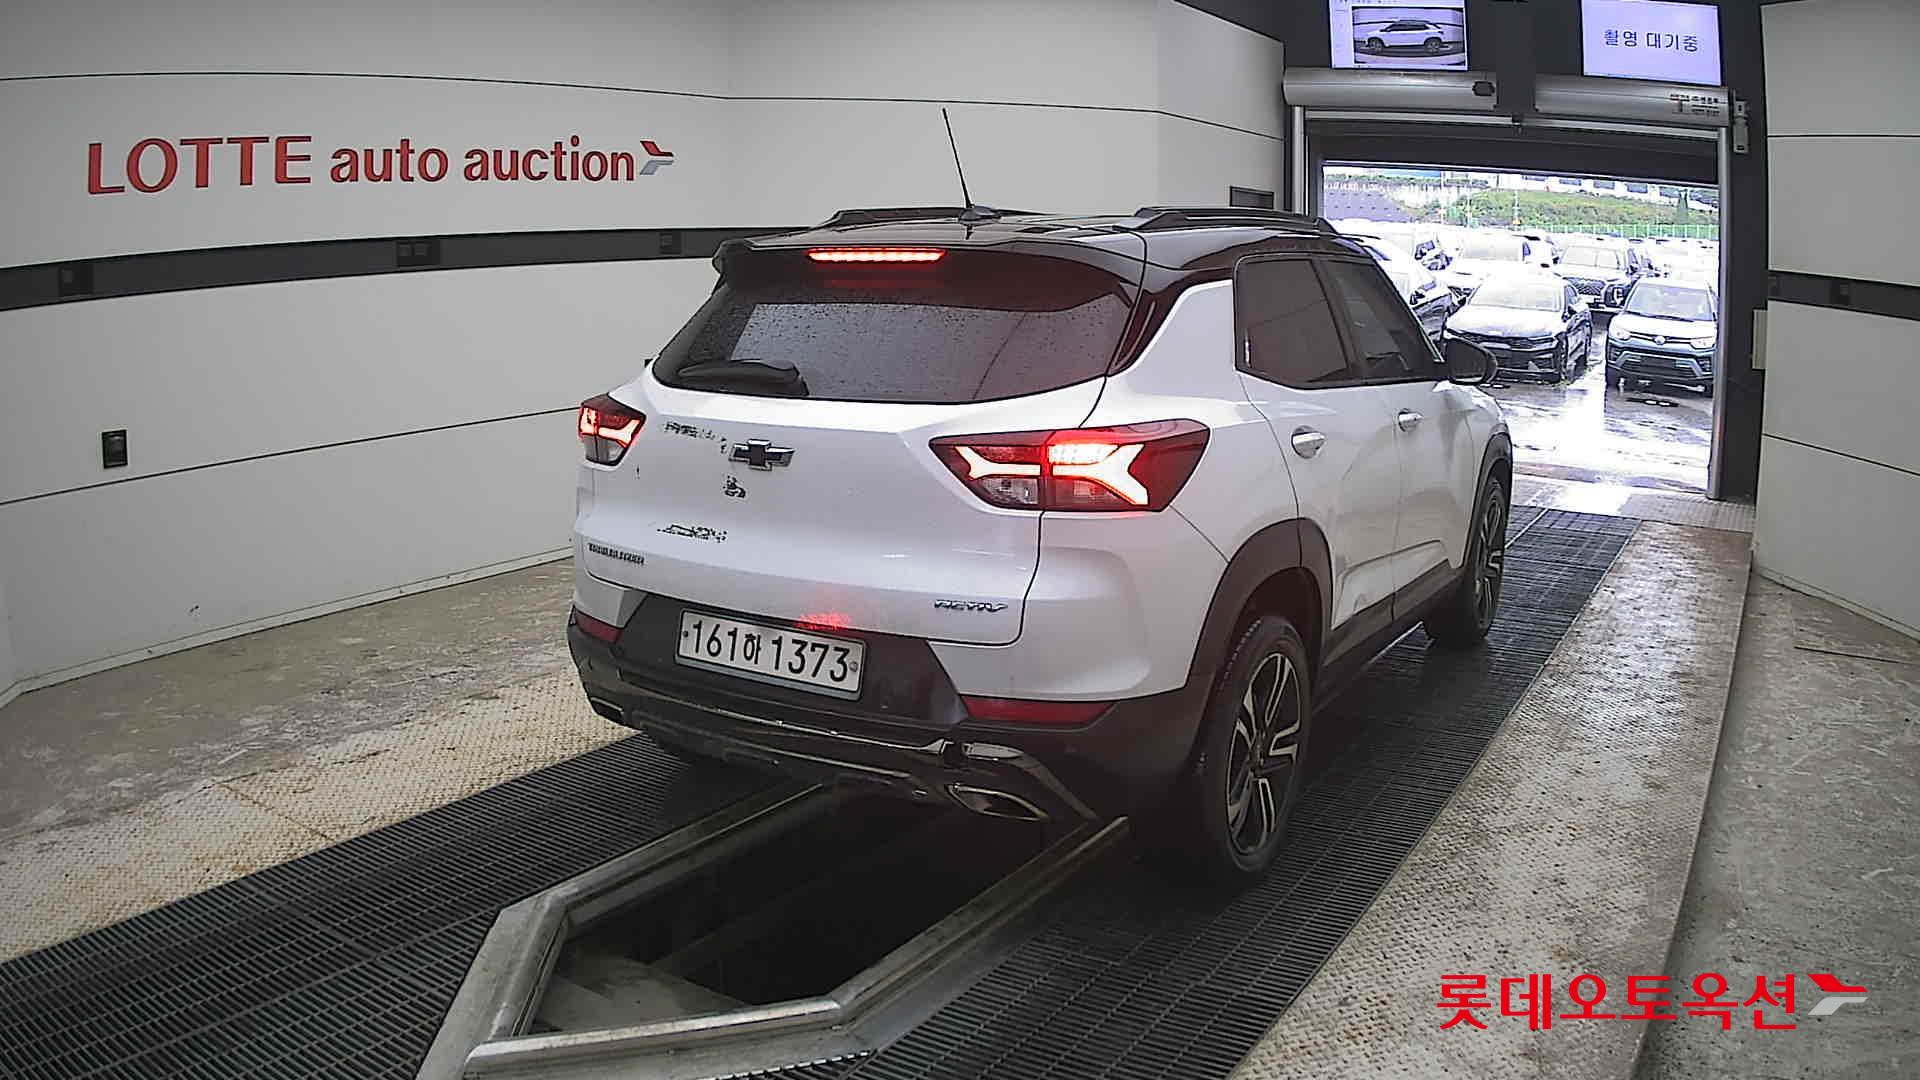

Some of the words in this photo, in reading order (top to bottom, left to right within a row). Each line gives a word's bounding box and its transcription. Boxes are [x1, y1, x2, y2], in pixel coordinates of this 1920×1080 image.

[1647, 32, 1698, 52] 대기중
[88, 136, 312, 195] LOTTE
[330, 139, 448, 184] auto
[463, 135, 634, 181] auction
[692, 619, 762, 665] 161하
[771, 635, 851, 683] 1373
